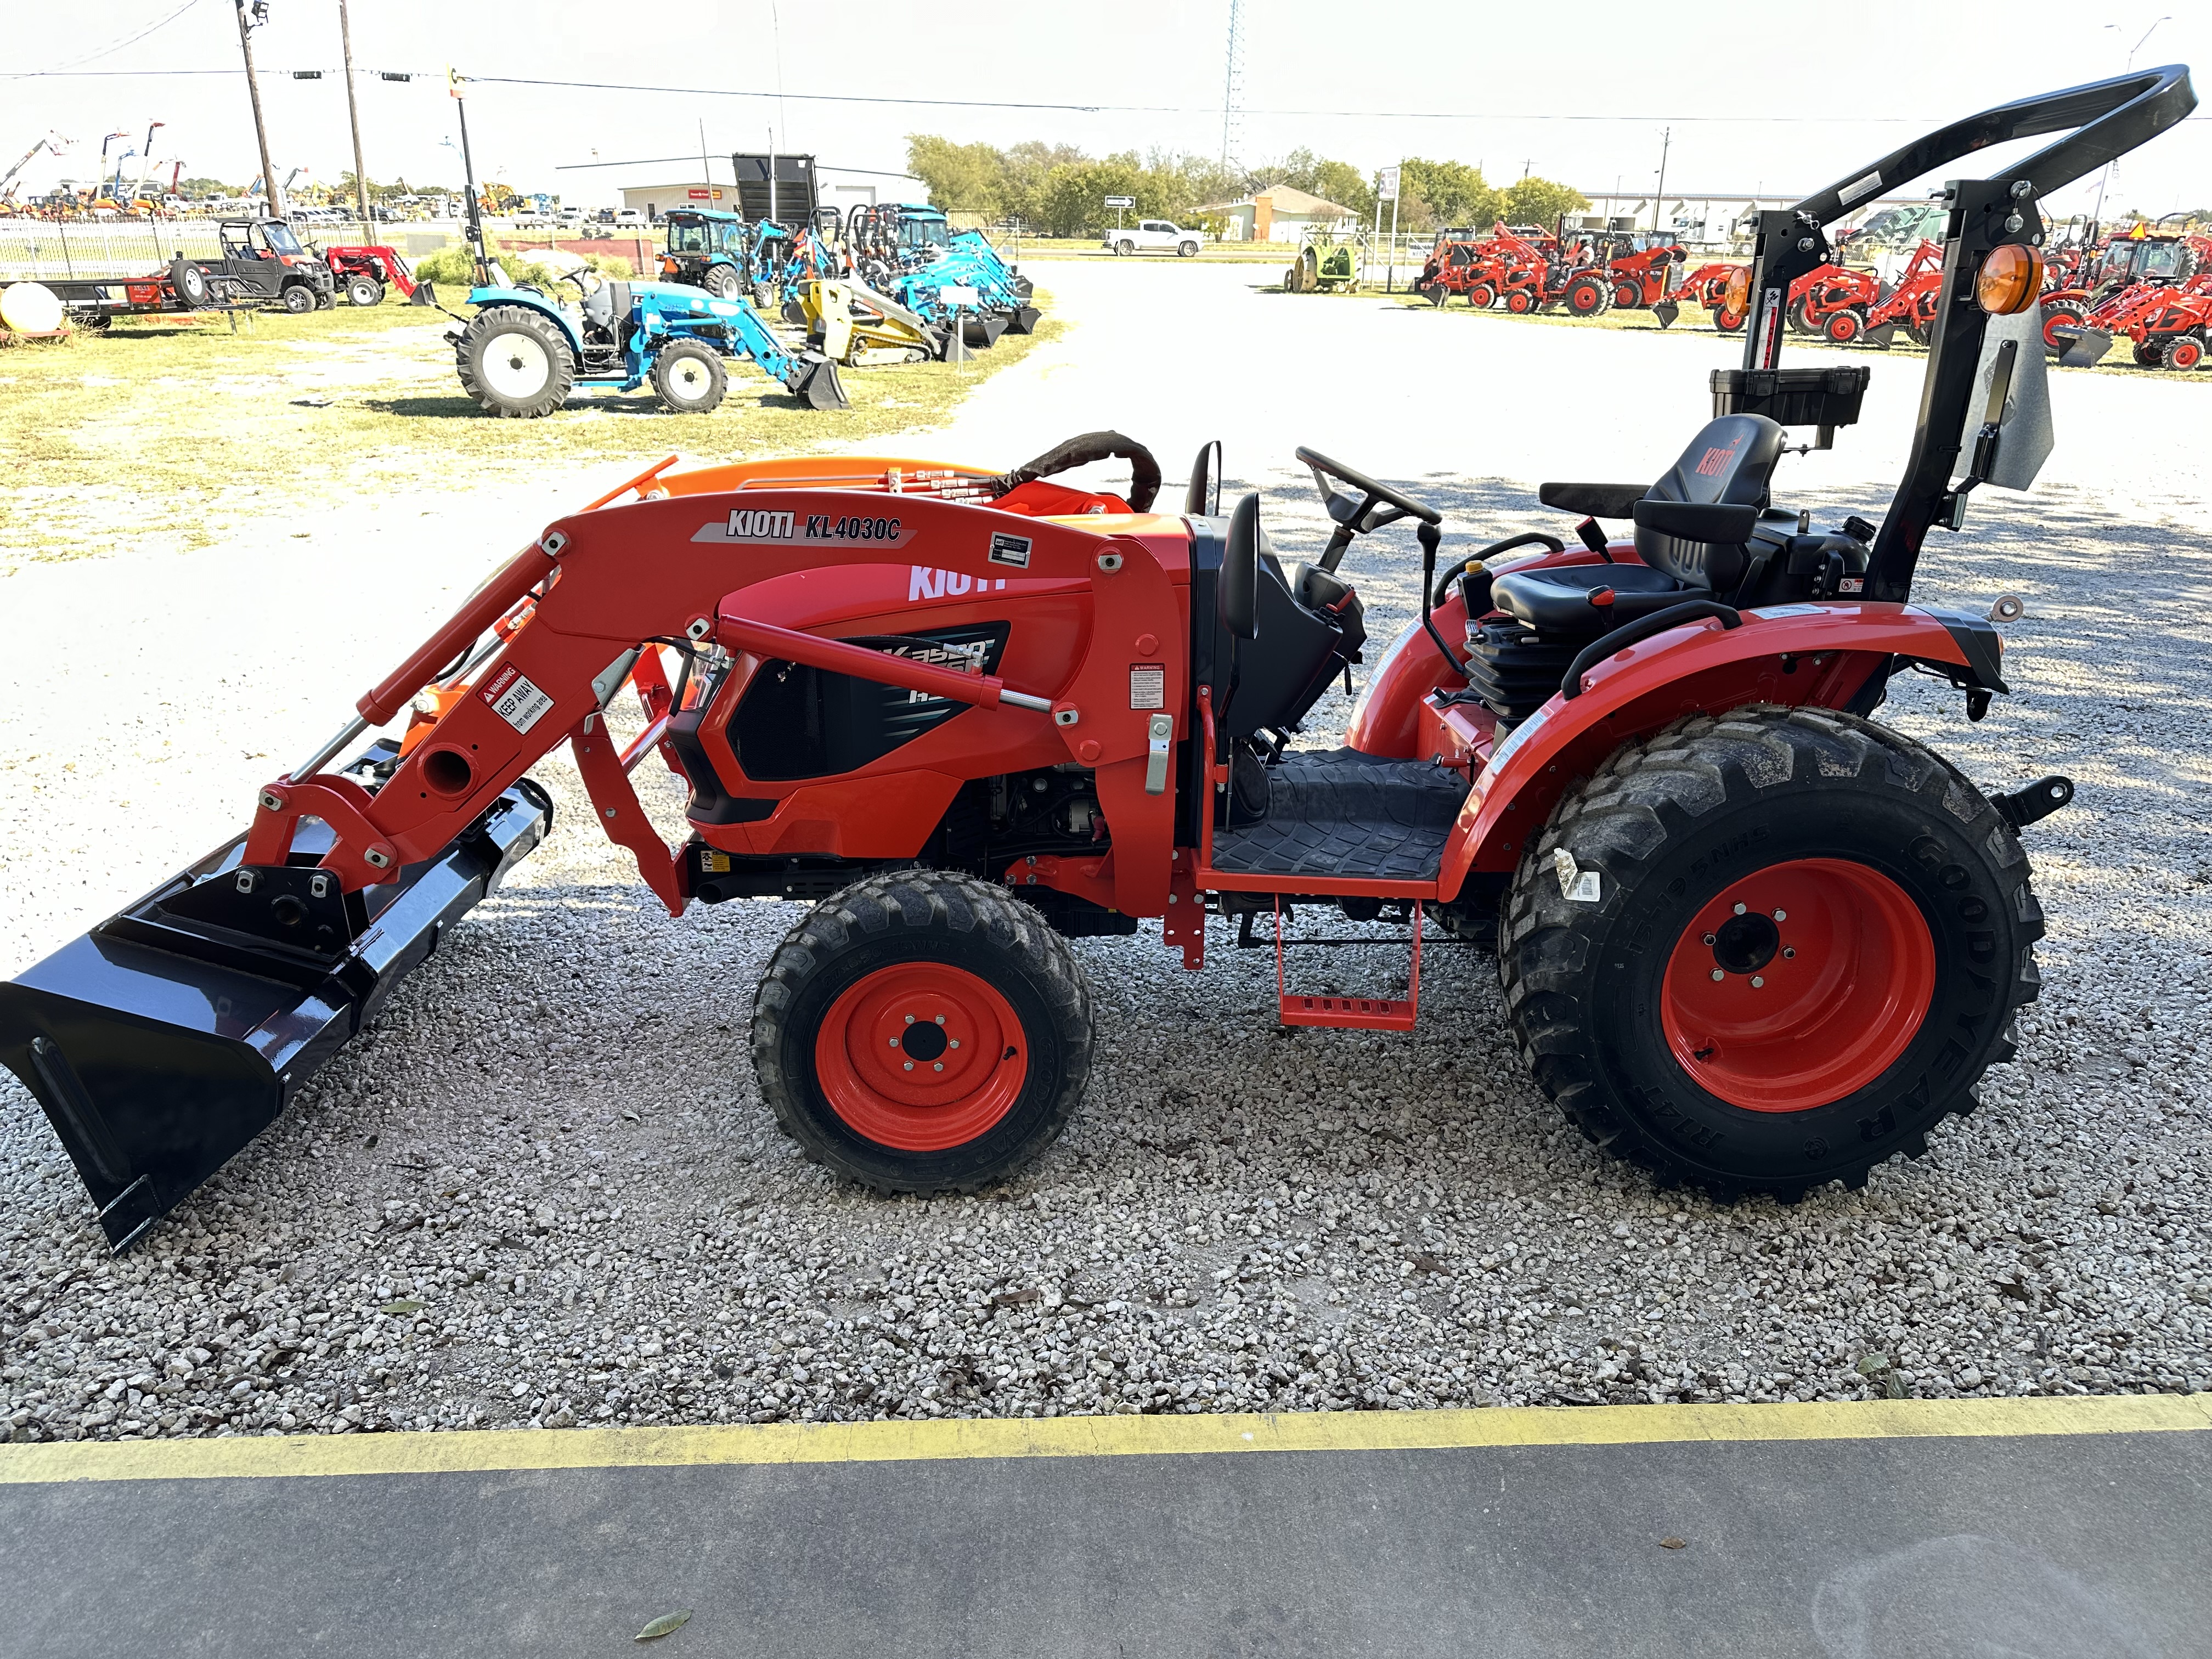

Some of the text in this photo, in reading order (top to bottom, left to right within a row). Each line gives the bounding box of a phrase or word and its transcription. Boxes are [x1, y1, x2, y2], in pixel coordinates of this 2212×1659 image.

[1695, 447, 1736, 478] KIOTI
[726, 509, 902, 541] KIOTI KL4030C
[488, 667, 516, 694] WARNING
[497, 680, 534, 719] KEEP AWAY
[512, 695, 548, 729] from working area
